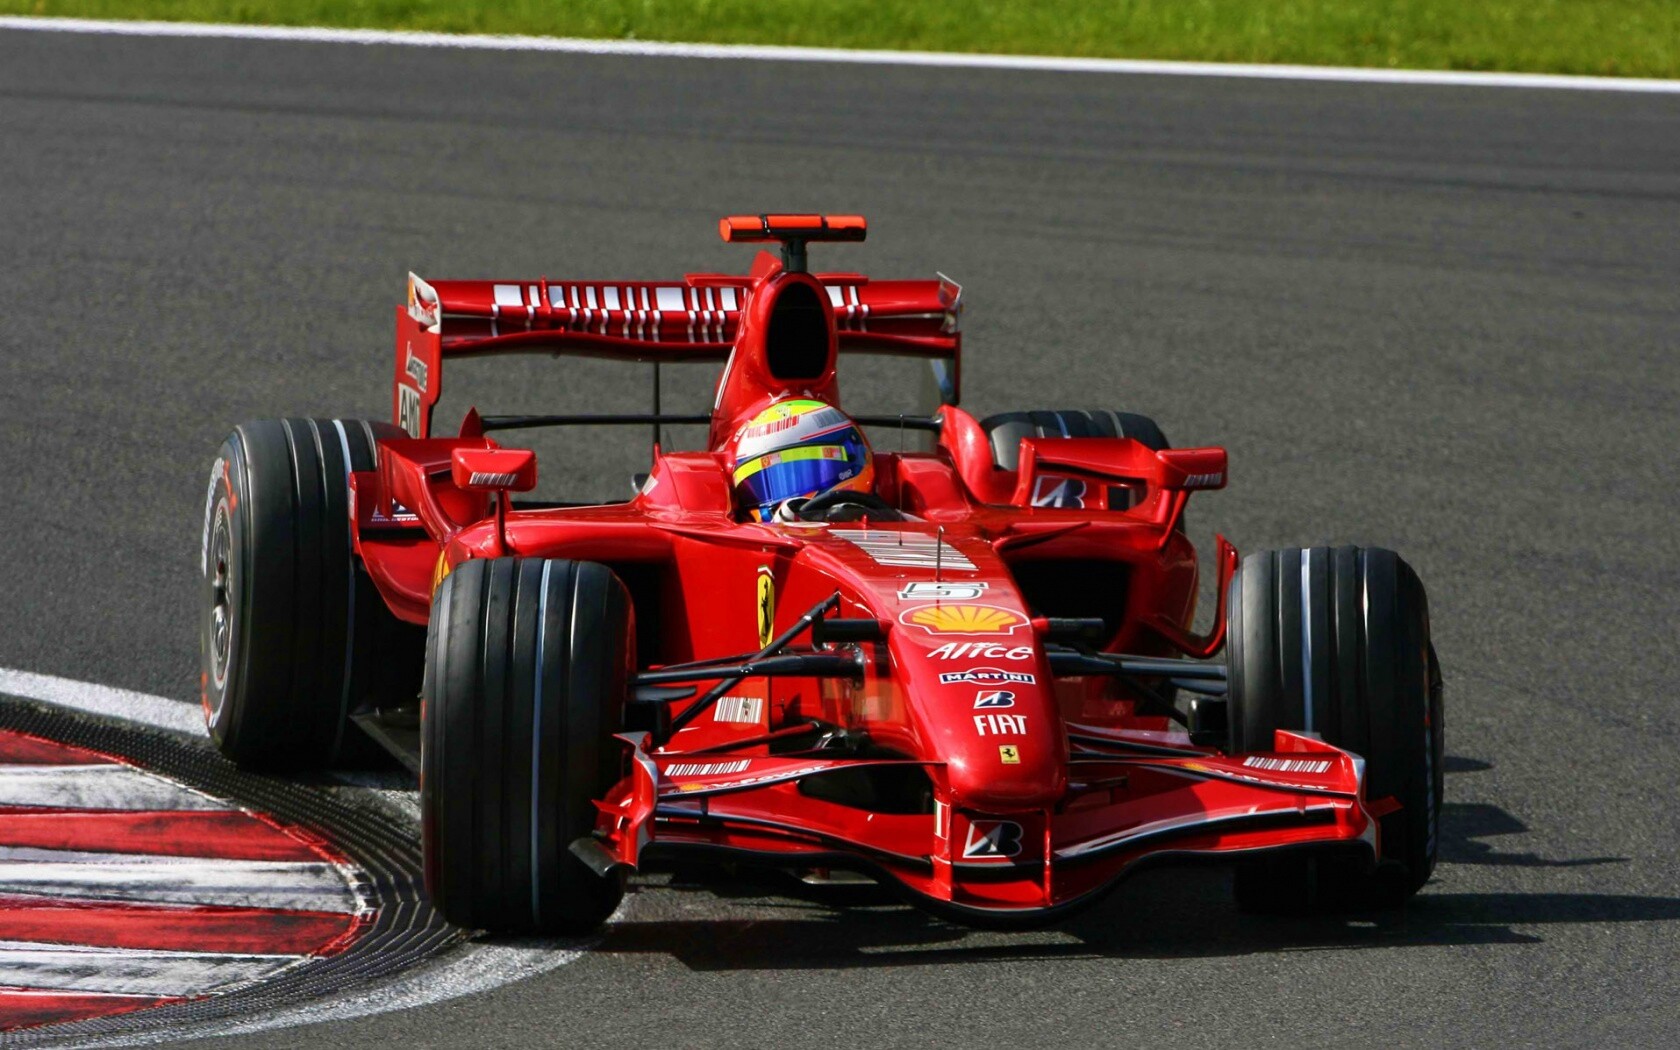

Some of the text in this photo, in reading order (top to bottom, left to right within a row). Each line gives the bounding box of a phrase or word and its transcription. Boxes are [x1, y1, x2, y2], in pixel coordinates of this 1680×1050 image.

[897, 582, 989, 600] 5
[926, 642, 1034, 660] Alice
[945, 672, 1030, 683] MARTINI
[973, 714, 1027, 736] FIAT
